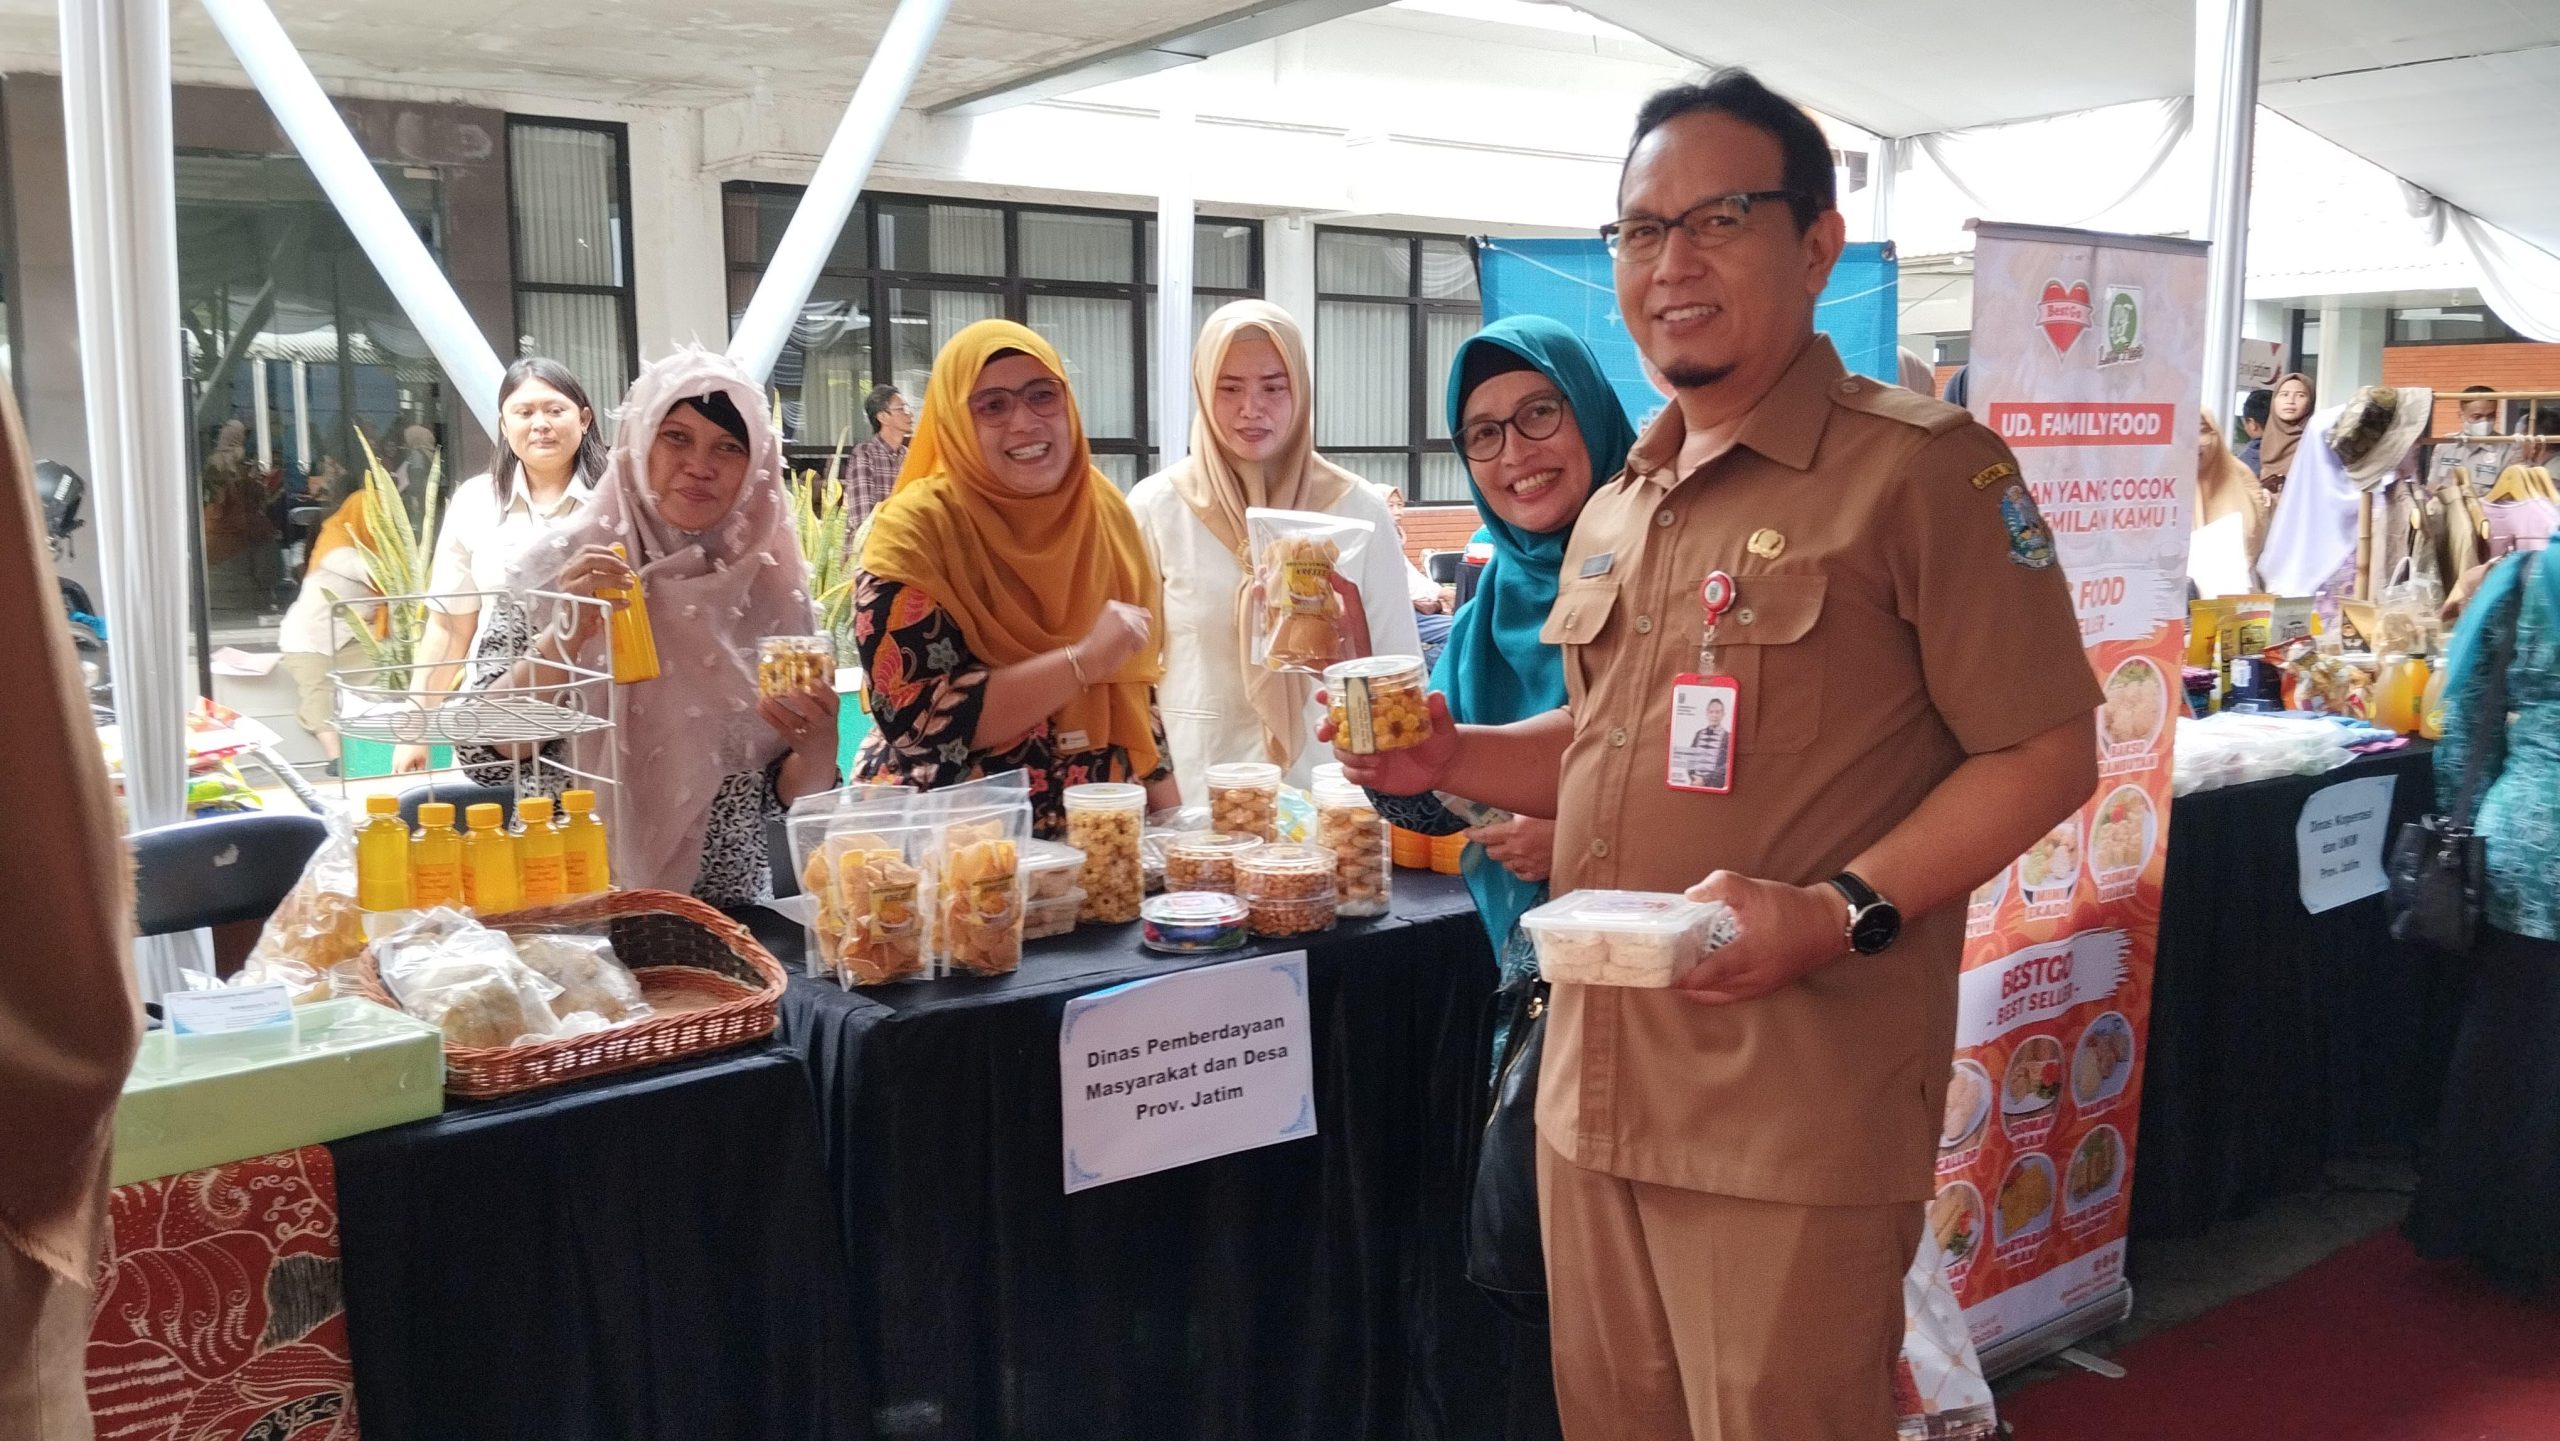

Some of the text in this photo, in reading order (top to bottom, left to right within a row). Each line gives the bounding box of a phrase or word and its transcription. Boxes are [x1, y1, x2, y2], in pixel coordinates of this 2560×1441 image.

[2002, 412, 2161, 437] UD. FAMILYFOOD
[2030, 481, 2052, 505] AN
[2111, 478, 2177, 501] COCOK
[2112, 507, 2165, 530] KAMU
[1997, 996, 2026, 1025] BEST
[1087, 1016, 1286, 1068] Dinas Pemberdayaan
[1086, 1046, 1288, 1100] Masyarakat dan Desa
[1136, 1085, 1244, 1120] Prov. Jatim
